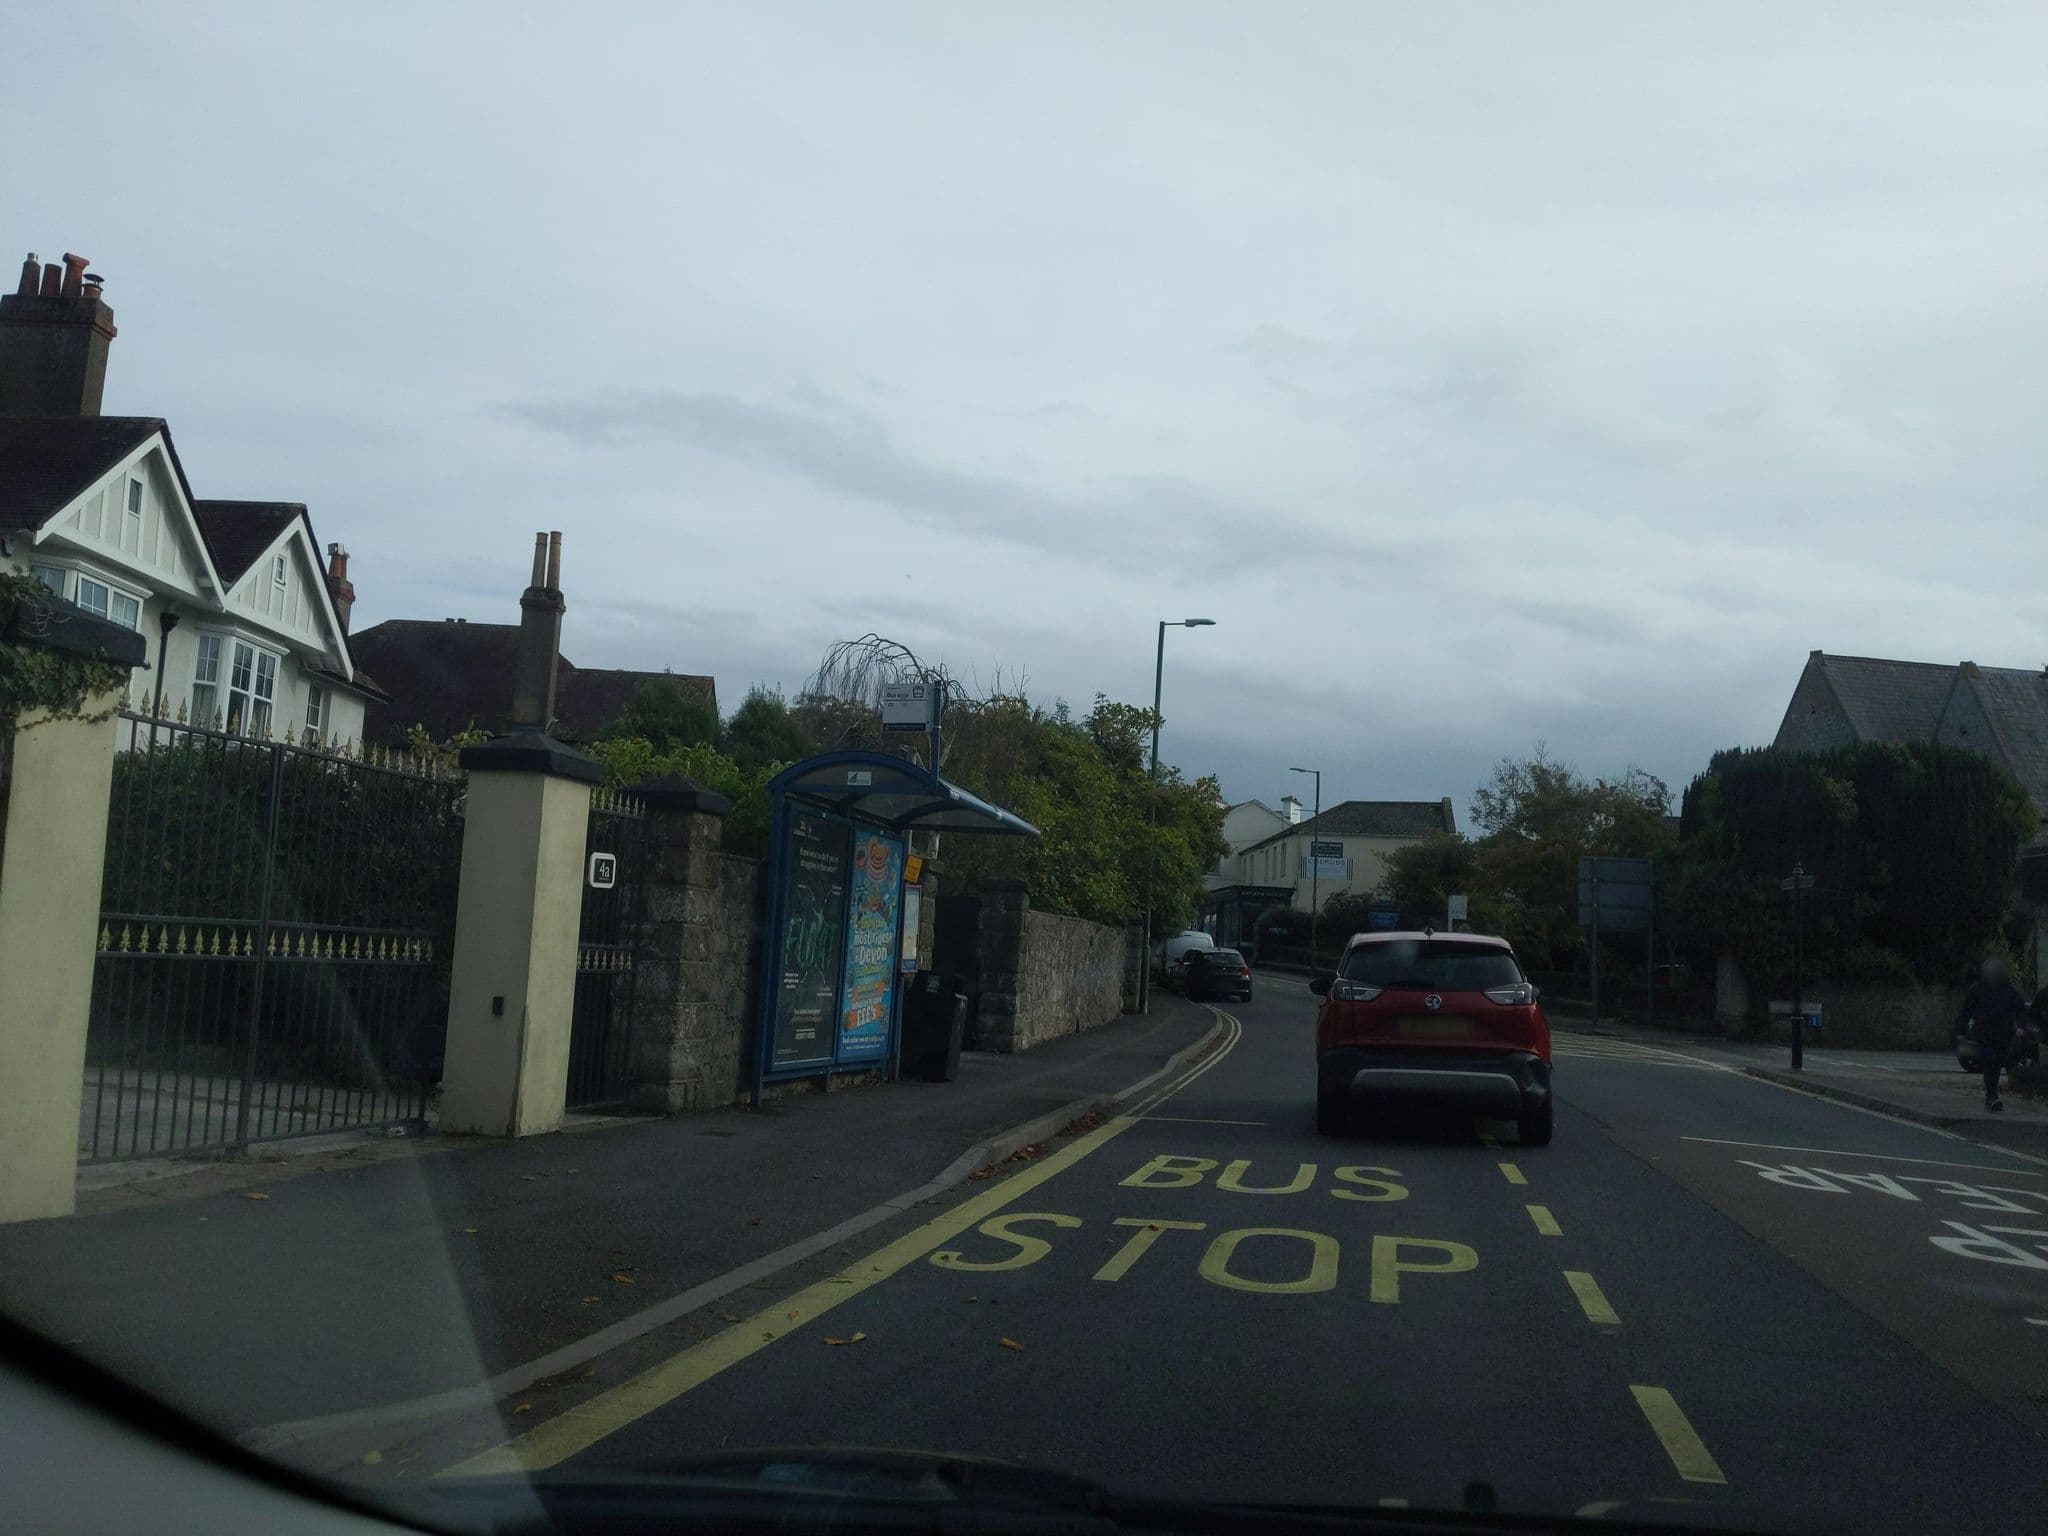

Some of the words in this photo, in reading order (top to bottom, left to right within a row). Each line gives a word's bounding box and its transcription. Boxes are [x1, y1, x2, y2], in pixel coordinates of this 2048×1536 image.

[599, 861, 610, 878] 4a
[1307, 857, 1346, 866] CERUBS
[860, 946, 888, 966] Devon
[1118, 1154, 1410, 1202] BUS
[928, 1212, 1480, 1305] STOP
